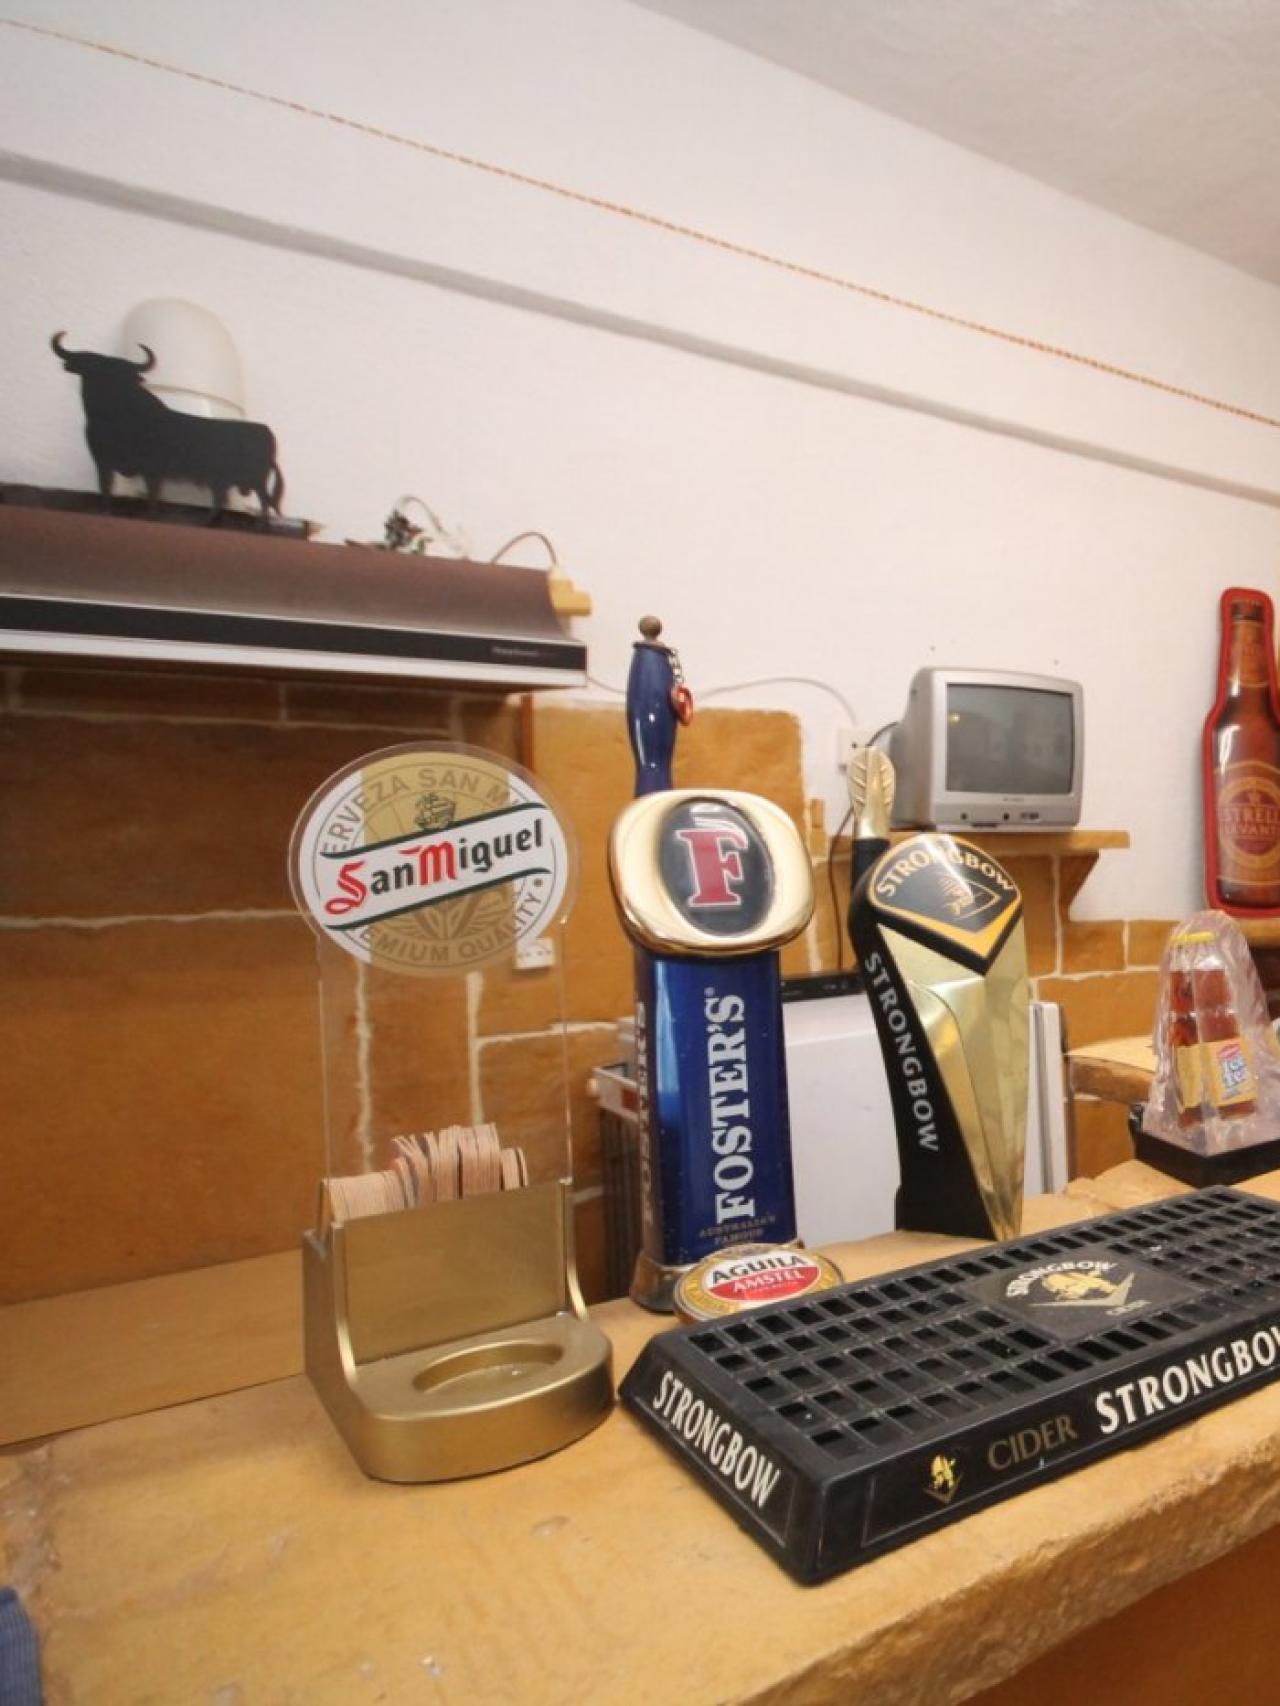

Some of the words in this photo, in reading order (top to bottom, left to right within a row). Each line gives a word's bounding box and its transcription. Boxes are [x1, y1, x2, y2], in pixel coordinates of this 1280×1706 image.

[322, 773, 411, 853] ERVEZA
[417, 767, 479, 793] SAN
[674, 827, 749, 908] F
[864, 951, 940, 1153] STRONGBOW
[732, 1269, 806, 1293] AMSTEL
[652, 1369, 781, 1509] STRONGBOW
[986, 1413, 1079, 1472] CIDER
